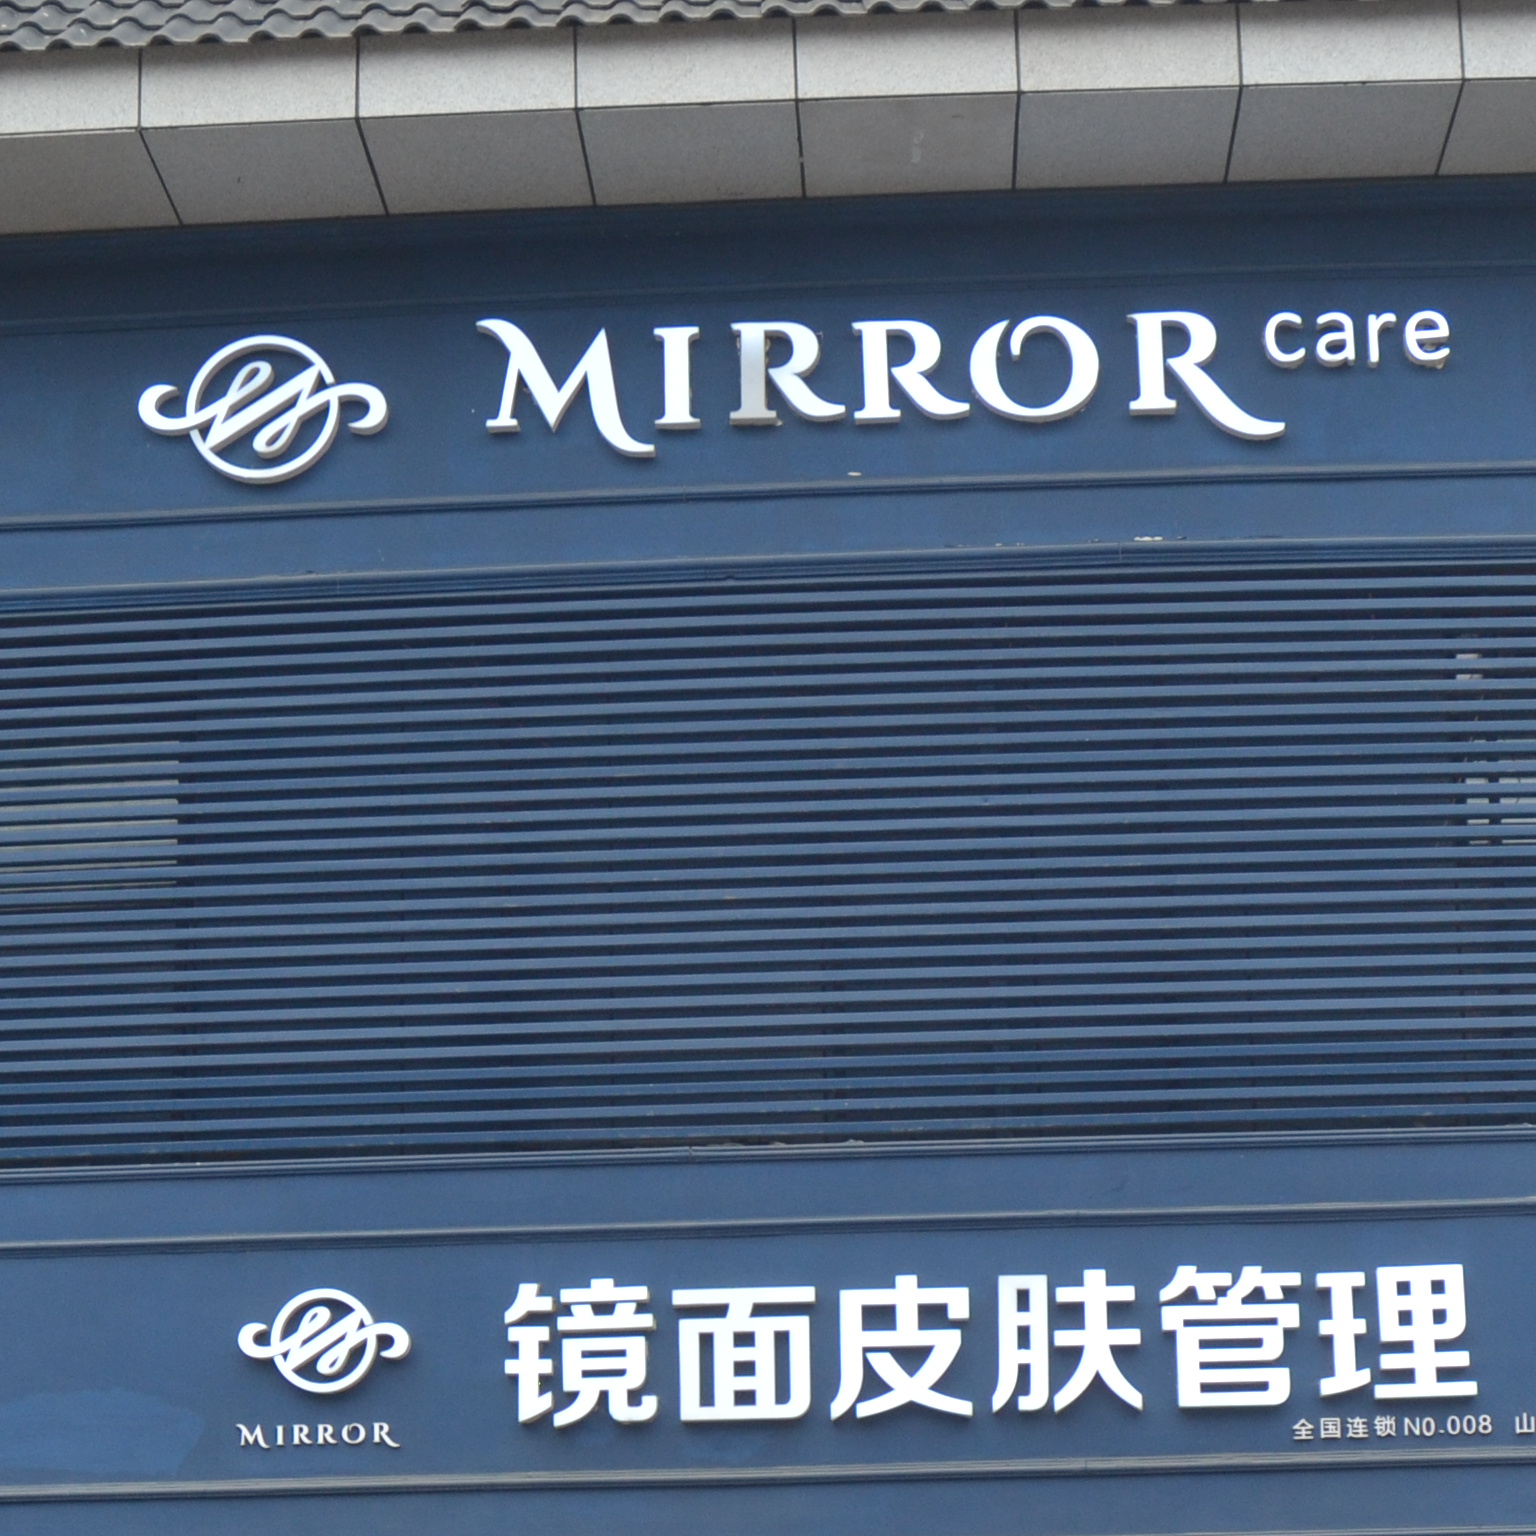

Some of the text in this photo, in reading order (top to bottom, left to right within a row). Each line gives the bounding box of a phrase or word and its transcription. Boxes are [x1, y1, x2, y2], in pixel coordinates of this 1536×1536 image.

[475, 309, 1452, 459] MIRROR care
[502, 1262, 1479, 1430] 镜面皮肤管理
[235, 1421, 402, 1450] MIRROR
